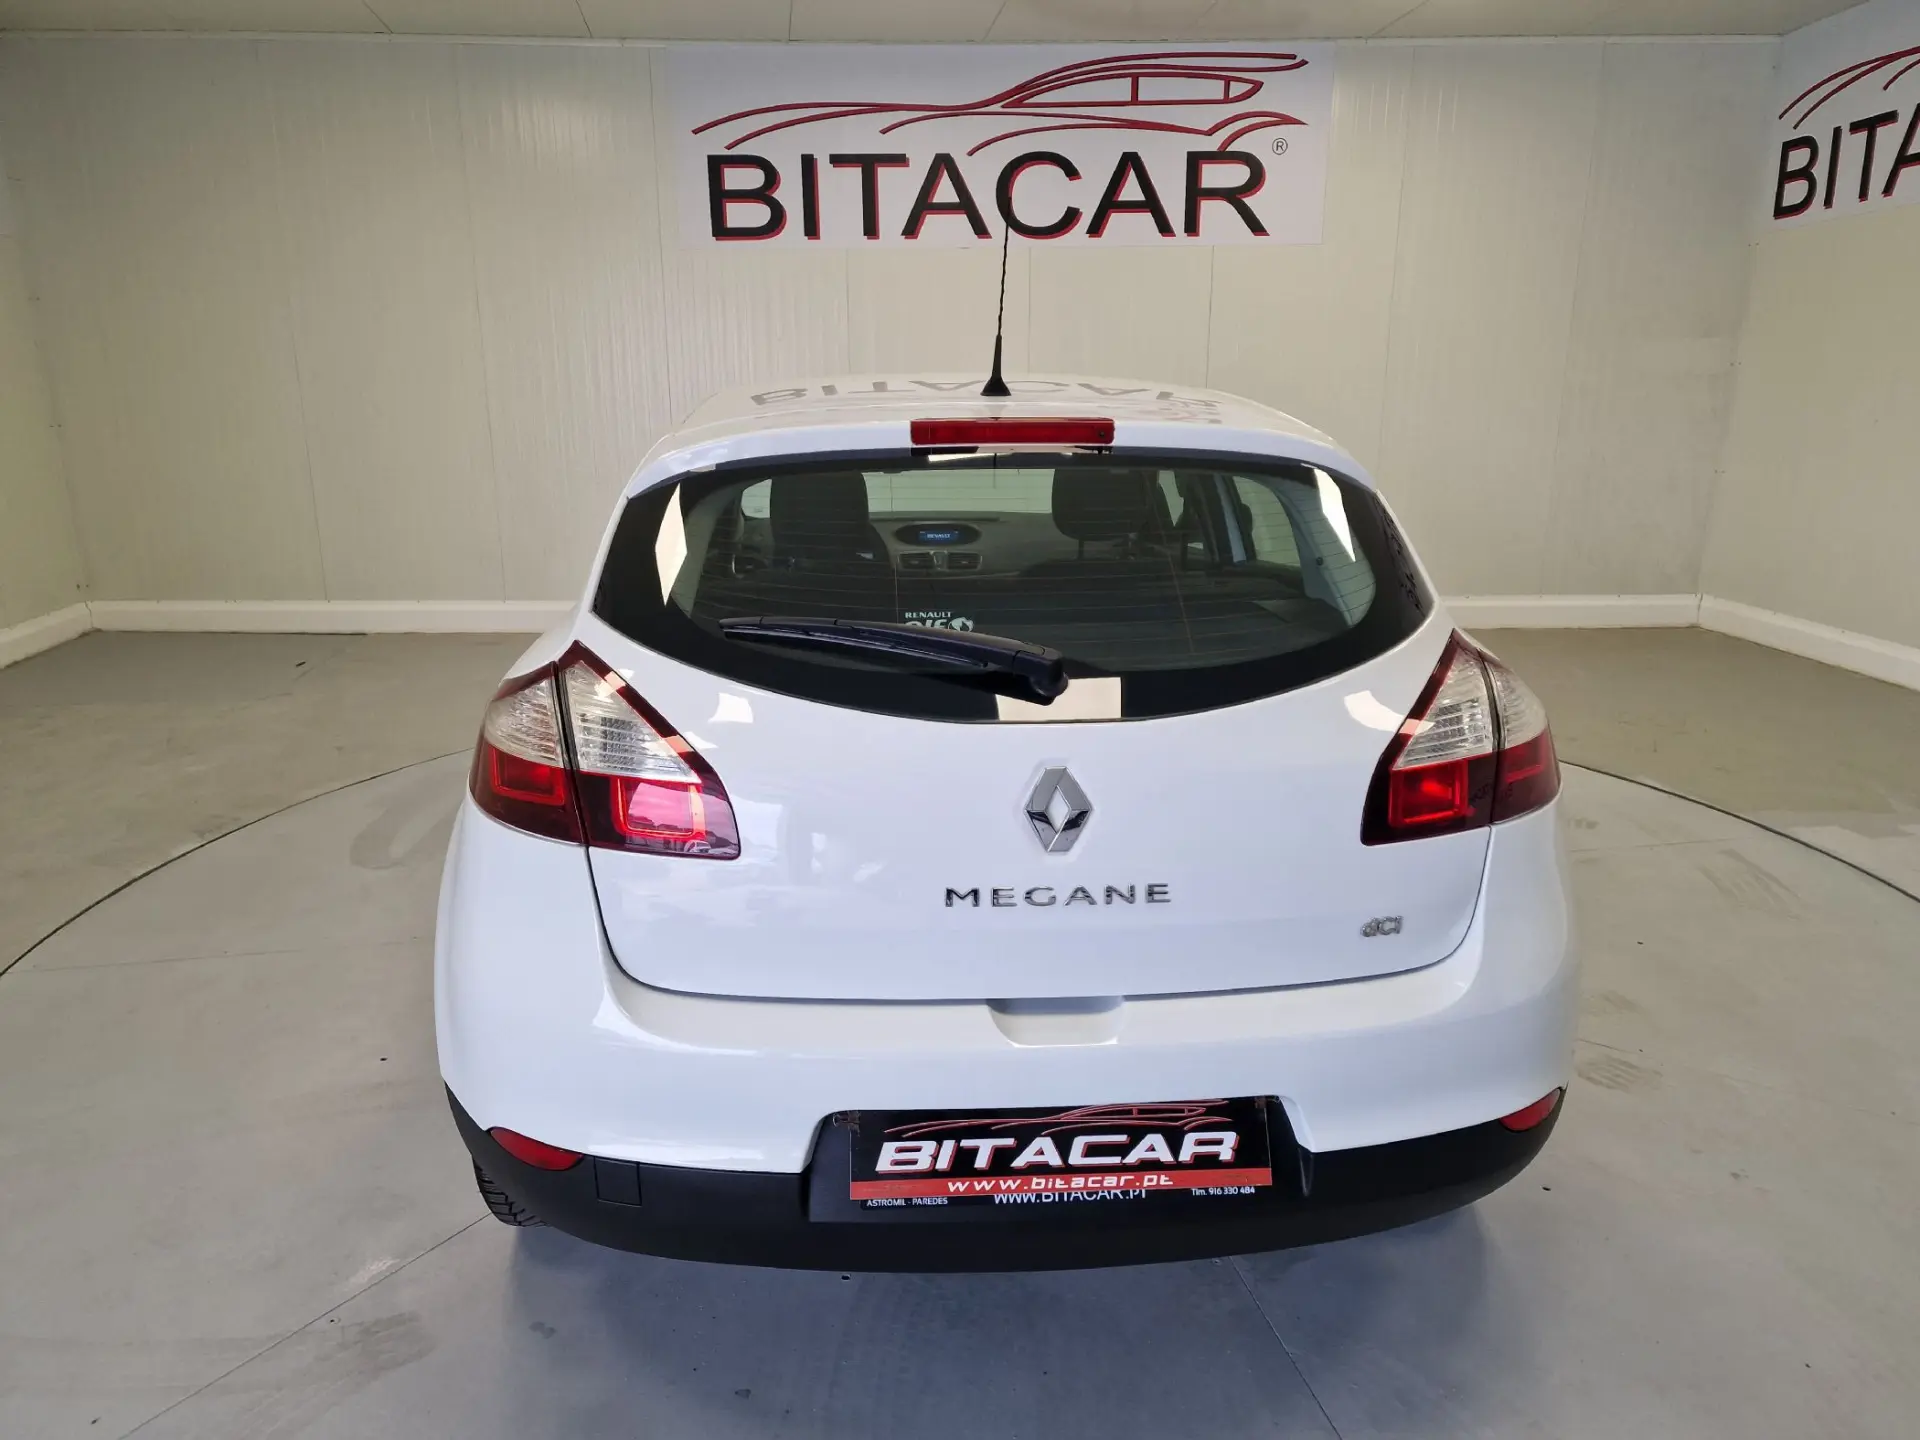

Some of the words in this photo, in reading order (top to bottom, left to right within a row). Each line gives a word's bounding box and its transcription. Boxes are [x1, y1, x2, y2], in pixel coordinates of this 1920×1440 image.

[707, 151, 1270, 241] BITACAR
[904, 611, 952, 619] RENAULT
[945, 883, 1172, 907] MEGANE
[875, 1131, 1240, 1175] BITACAR
[947, 1174, 1174, 1193] www.bitacar.pt
[1208, 1187, 1222, 1196] 916
[1223, 1186, 1239, 1195] 330
[1240, 1186, 1256, 1194] 484
[866, 1198, 907, 1207] ASTROMIL
[912, 1197, 949, 1206] PAREDES
